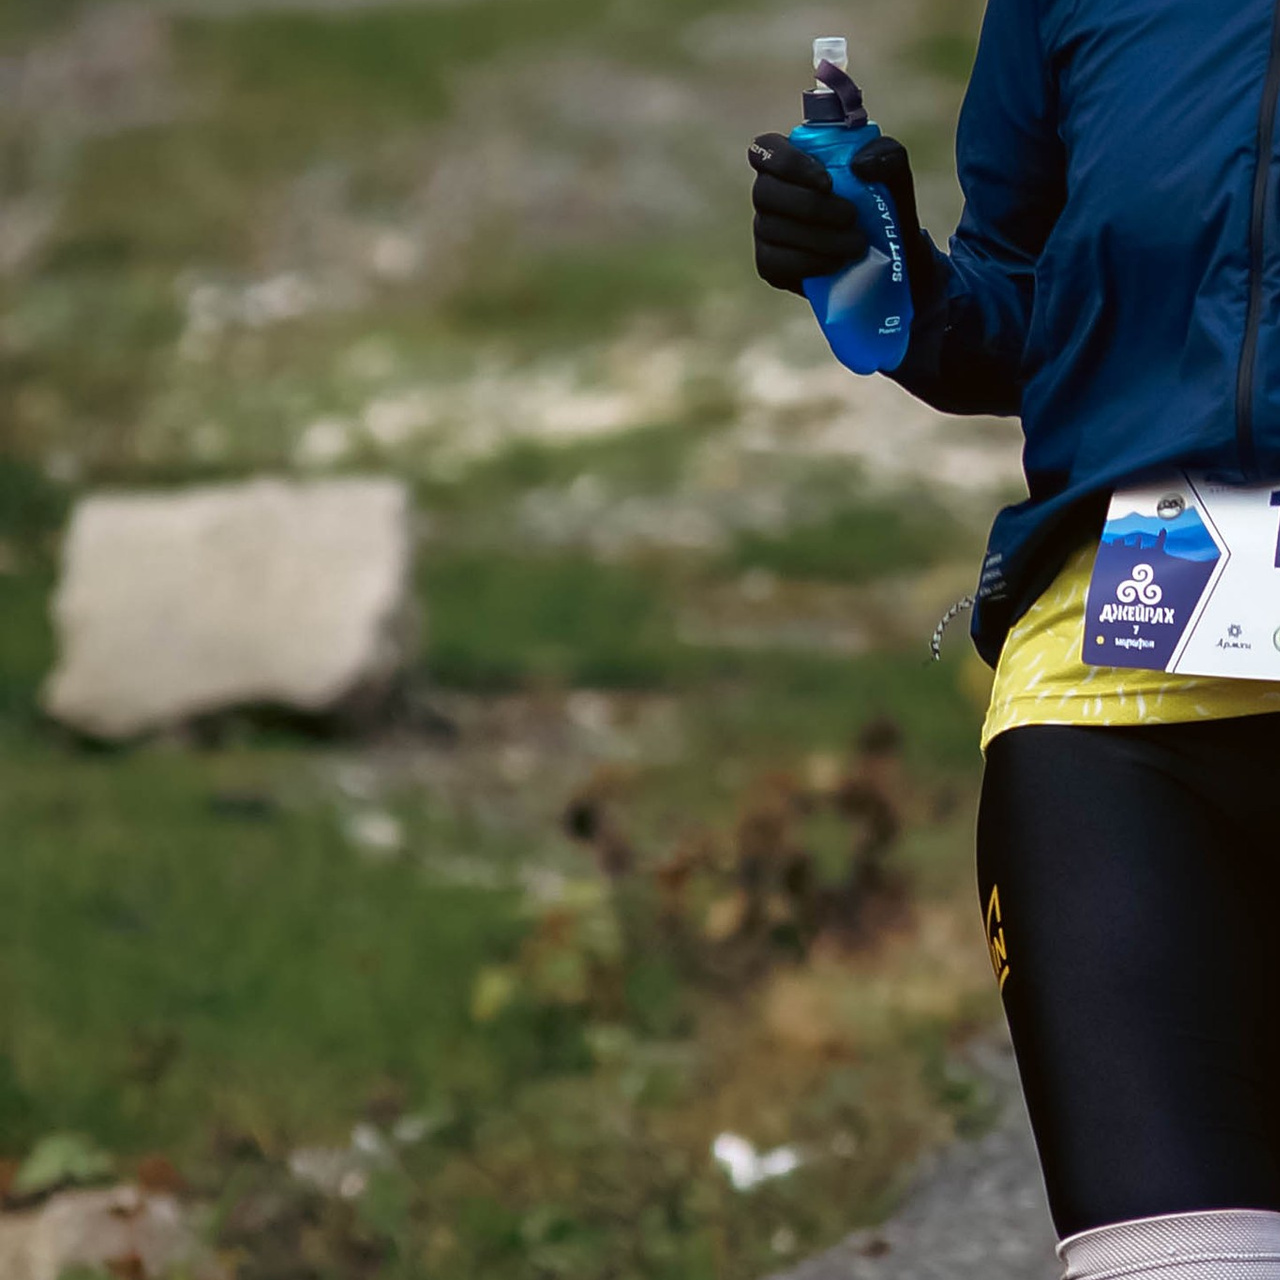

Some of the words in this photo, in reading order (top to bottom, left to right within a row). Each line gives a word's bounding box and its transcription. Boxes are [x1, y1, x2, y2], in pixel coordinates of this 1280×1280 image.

[889, 242, 902, 282] SOFT
[1099, 603, 1175, 624] ДЖЕЙРАХ
[1133, 625, 1140, 635] 7
